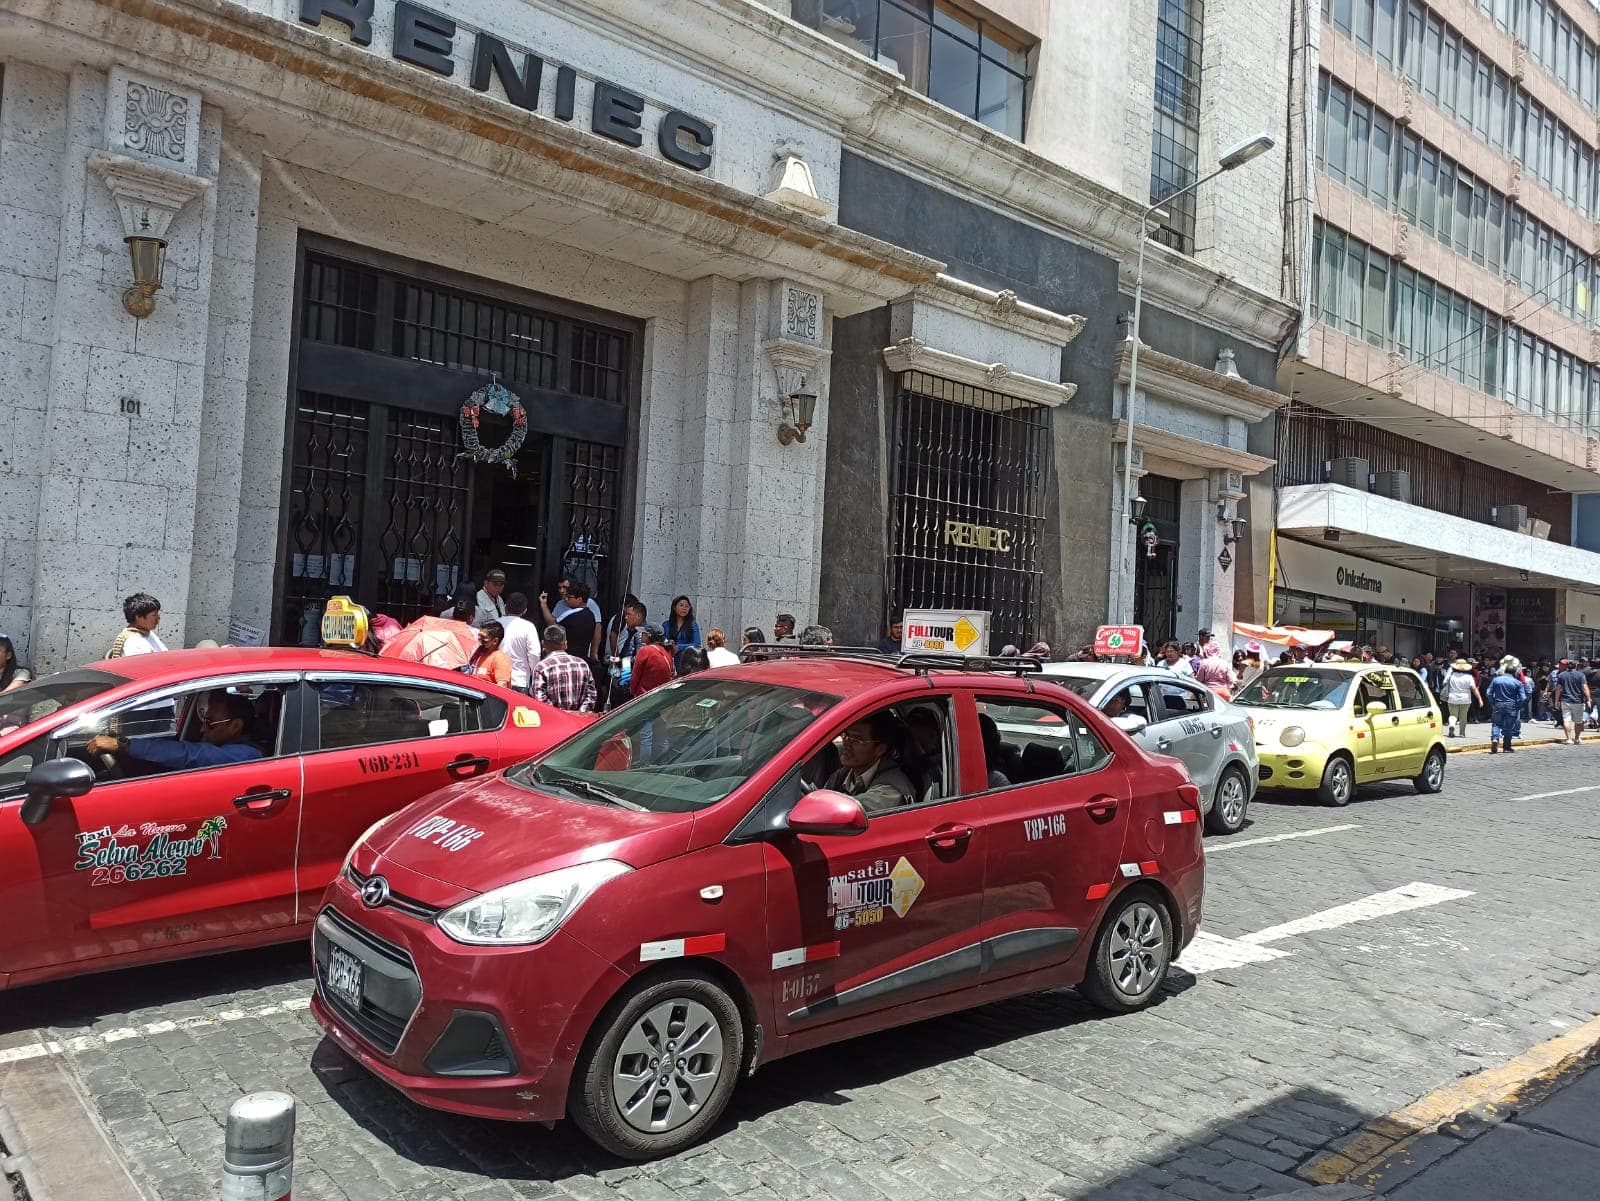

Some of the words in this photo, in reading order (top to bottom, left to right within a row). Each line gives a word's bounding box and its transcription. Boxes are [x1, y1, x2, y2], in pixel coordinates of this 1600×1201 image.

[300, 0, 714, 172] RENIEC
[120, 397, 140, 416] 101
[944, 520, 1011, 553] RENIEC
[1344, 567, 1382, 593] Inkafarma
[357, 751, 420, 775] V6B-231
[75, 826, 111, 844] Taxi
[111, 825, 137, 838] La
[139, 822, 188, 836] Nueva
[1023, 813, 1066, 842] V8P-166
[74, 838, 139, 871] Selva
[140, 832, 204, 863] Alegre
[91, 858, 187, 887] 266262
